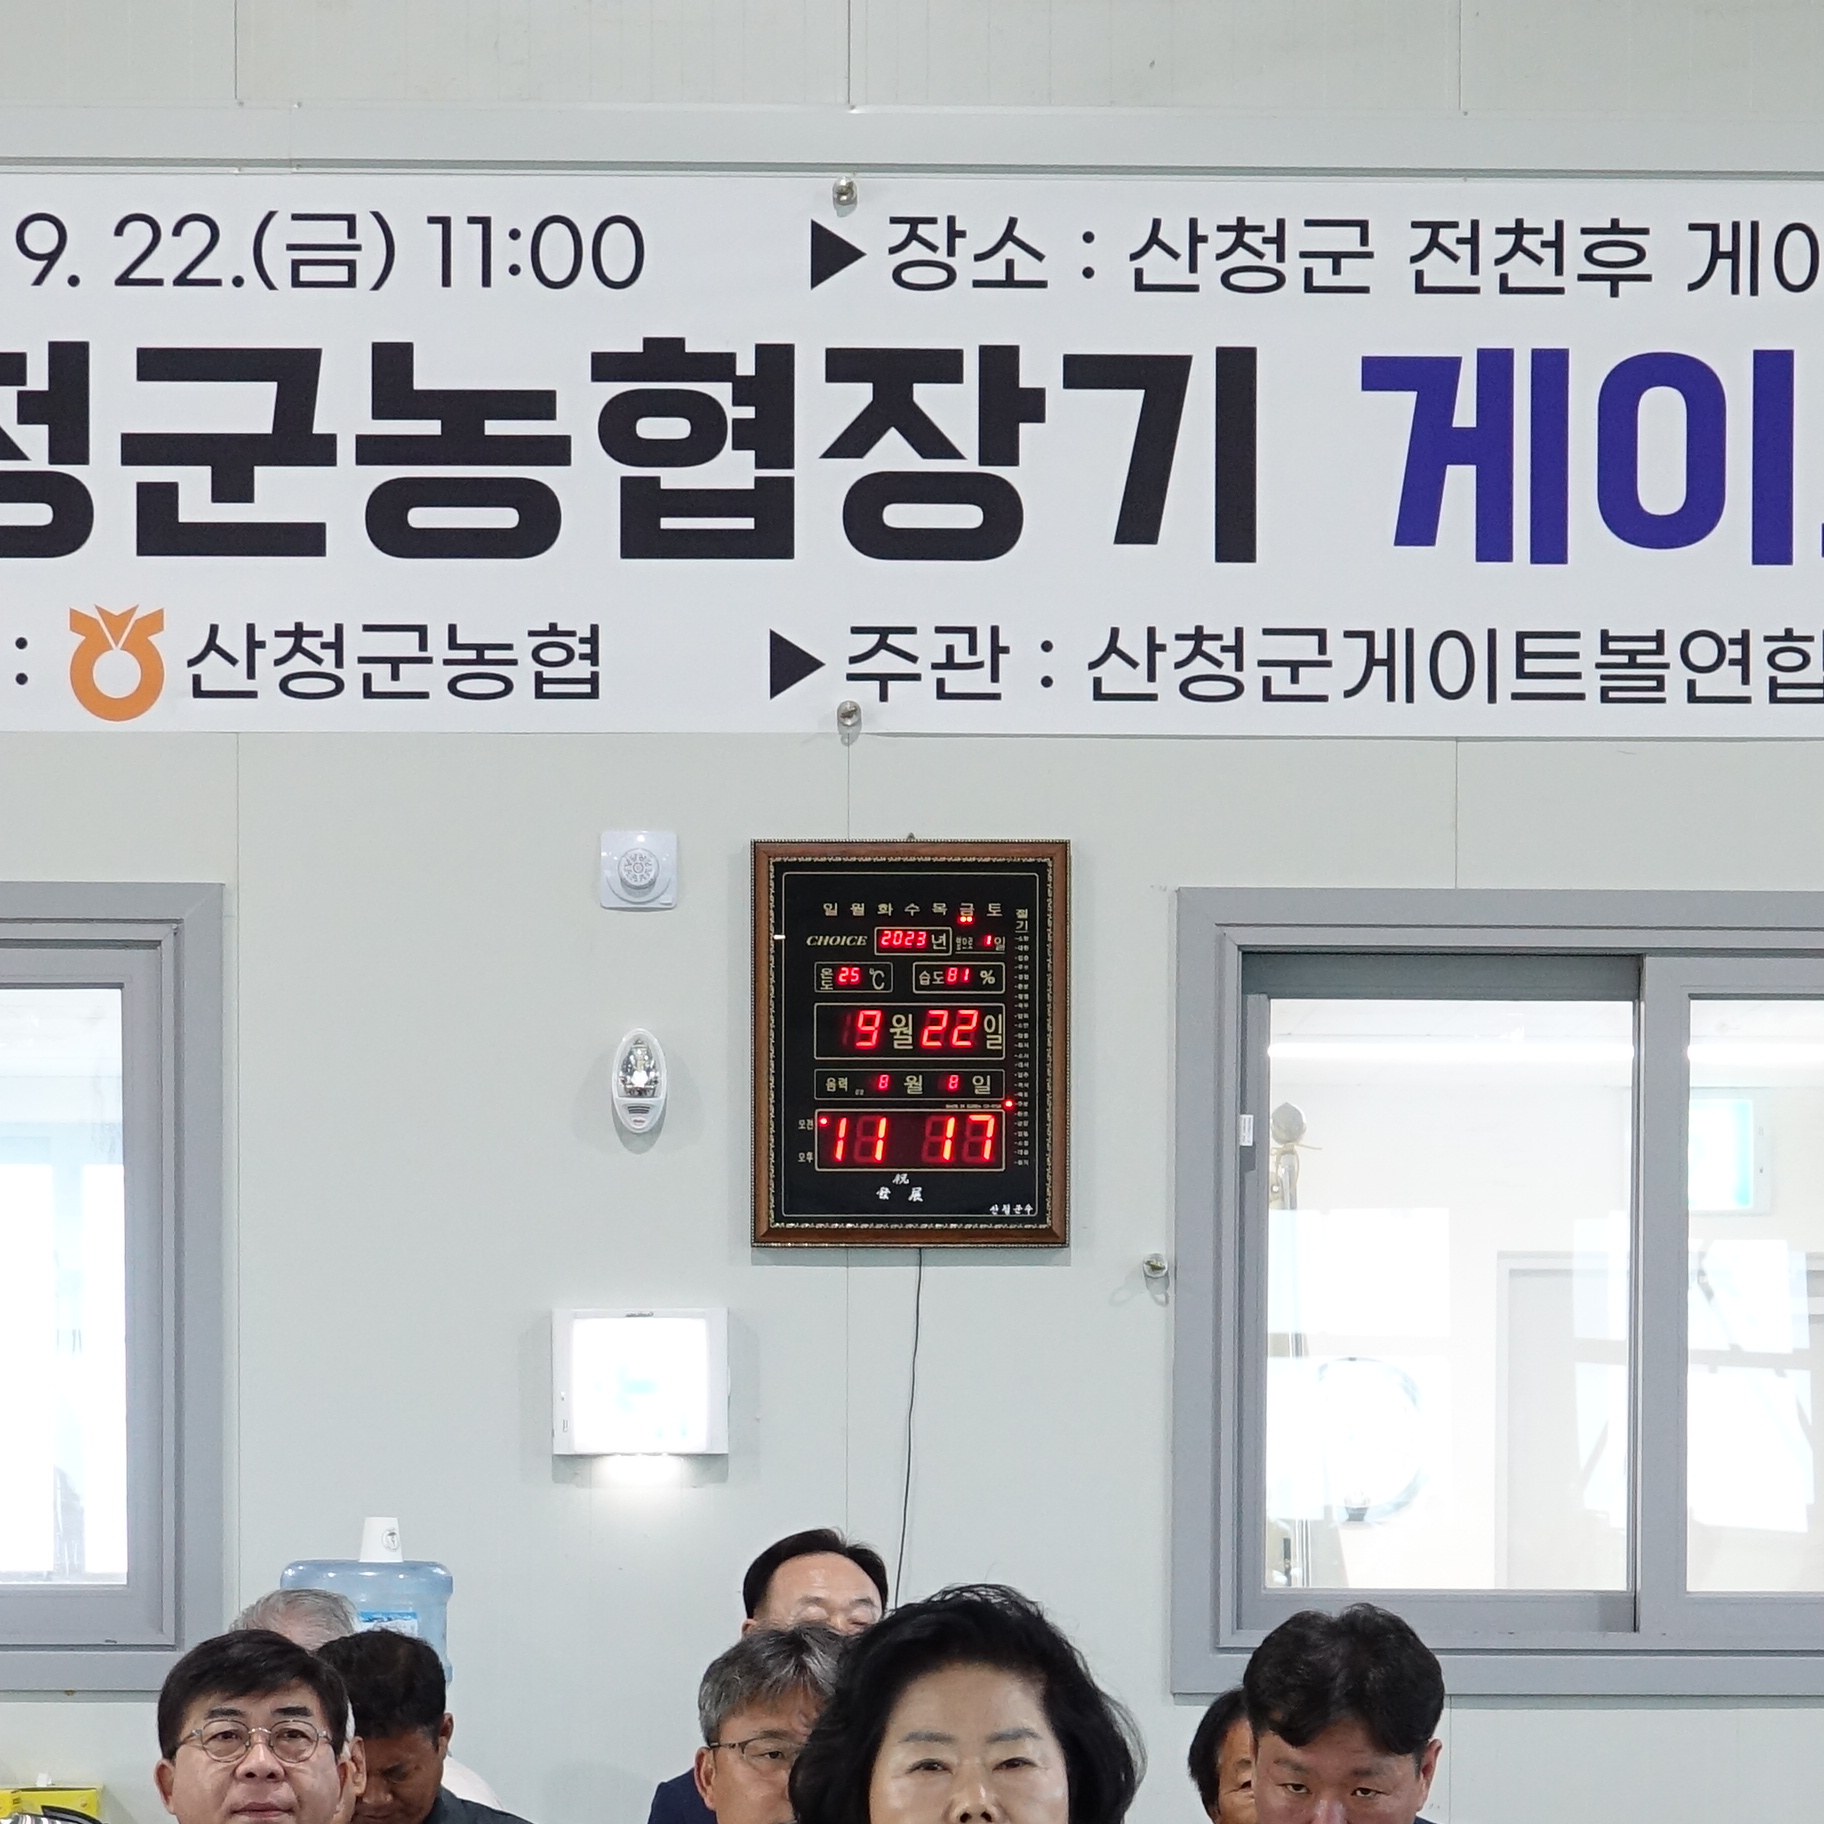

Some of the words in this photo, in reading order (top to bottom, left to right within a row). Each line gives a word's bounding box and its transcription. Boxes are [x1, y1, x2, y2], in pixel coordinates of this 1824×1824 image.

[15, 212, 81, 288] 9.
[113, 210, 396, 291] 22.(금)
[426, 214, 645, 290] 11:00
[889, 214, 1048, 292] 장소
[1129, 216, 1375, 294] 산청군
[1409, 217, 1653, 298] 전천후
[186, 621, 600, 701] 산청군농협
[841, 624, 1010, 701] 주관
[823, 903, 838, 916] 일
[850, 903, 865, 916] 월
[877, 903, 893, 916] 화
[904, 903, 920, 916] 수
[932, 903, 947, 916] 목
[959, 903, 974, 917] 금
[986, 903, 1003, 917] 토
[806, 935, 868, 946] CHOICE
[838, 967, 861, 984] 25
[979, 970, 996, 985] %
[825, 1077, 848, 1092] 음력
